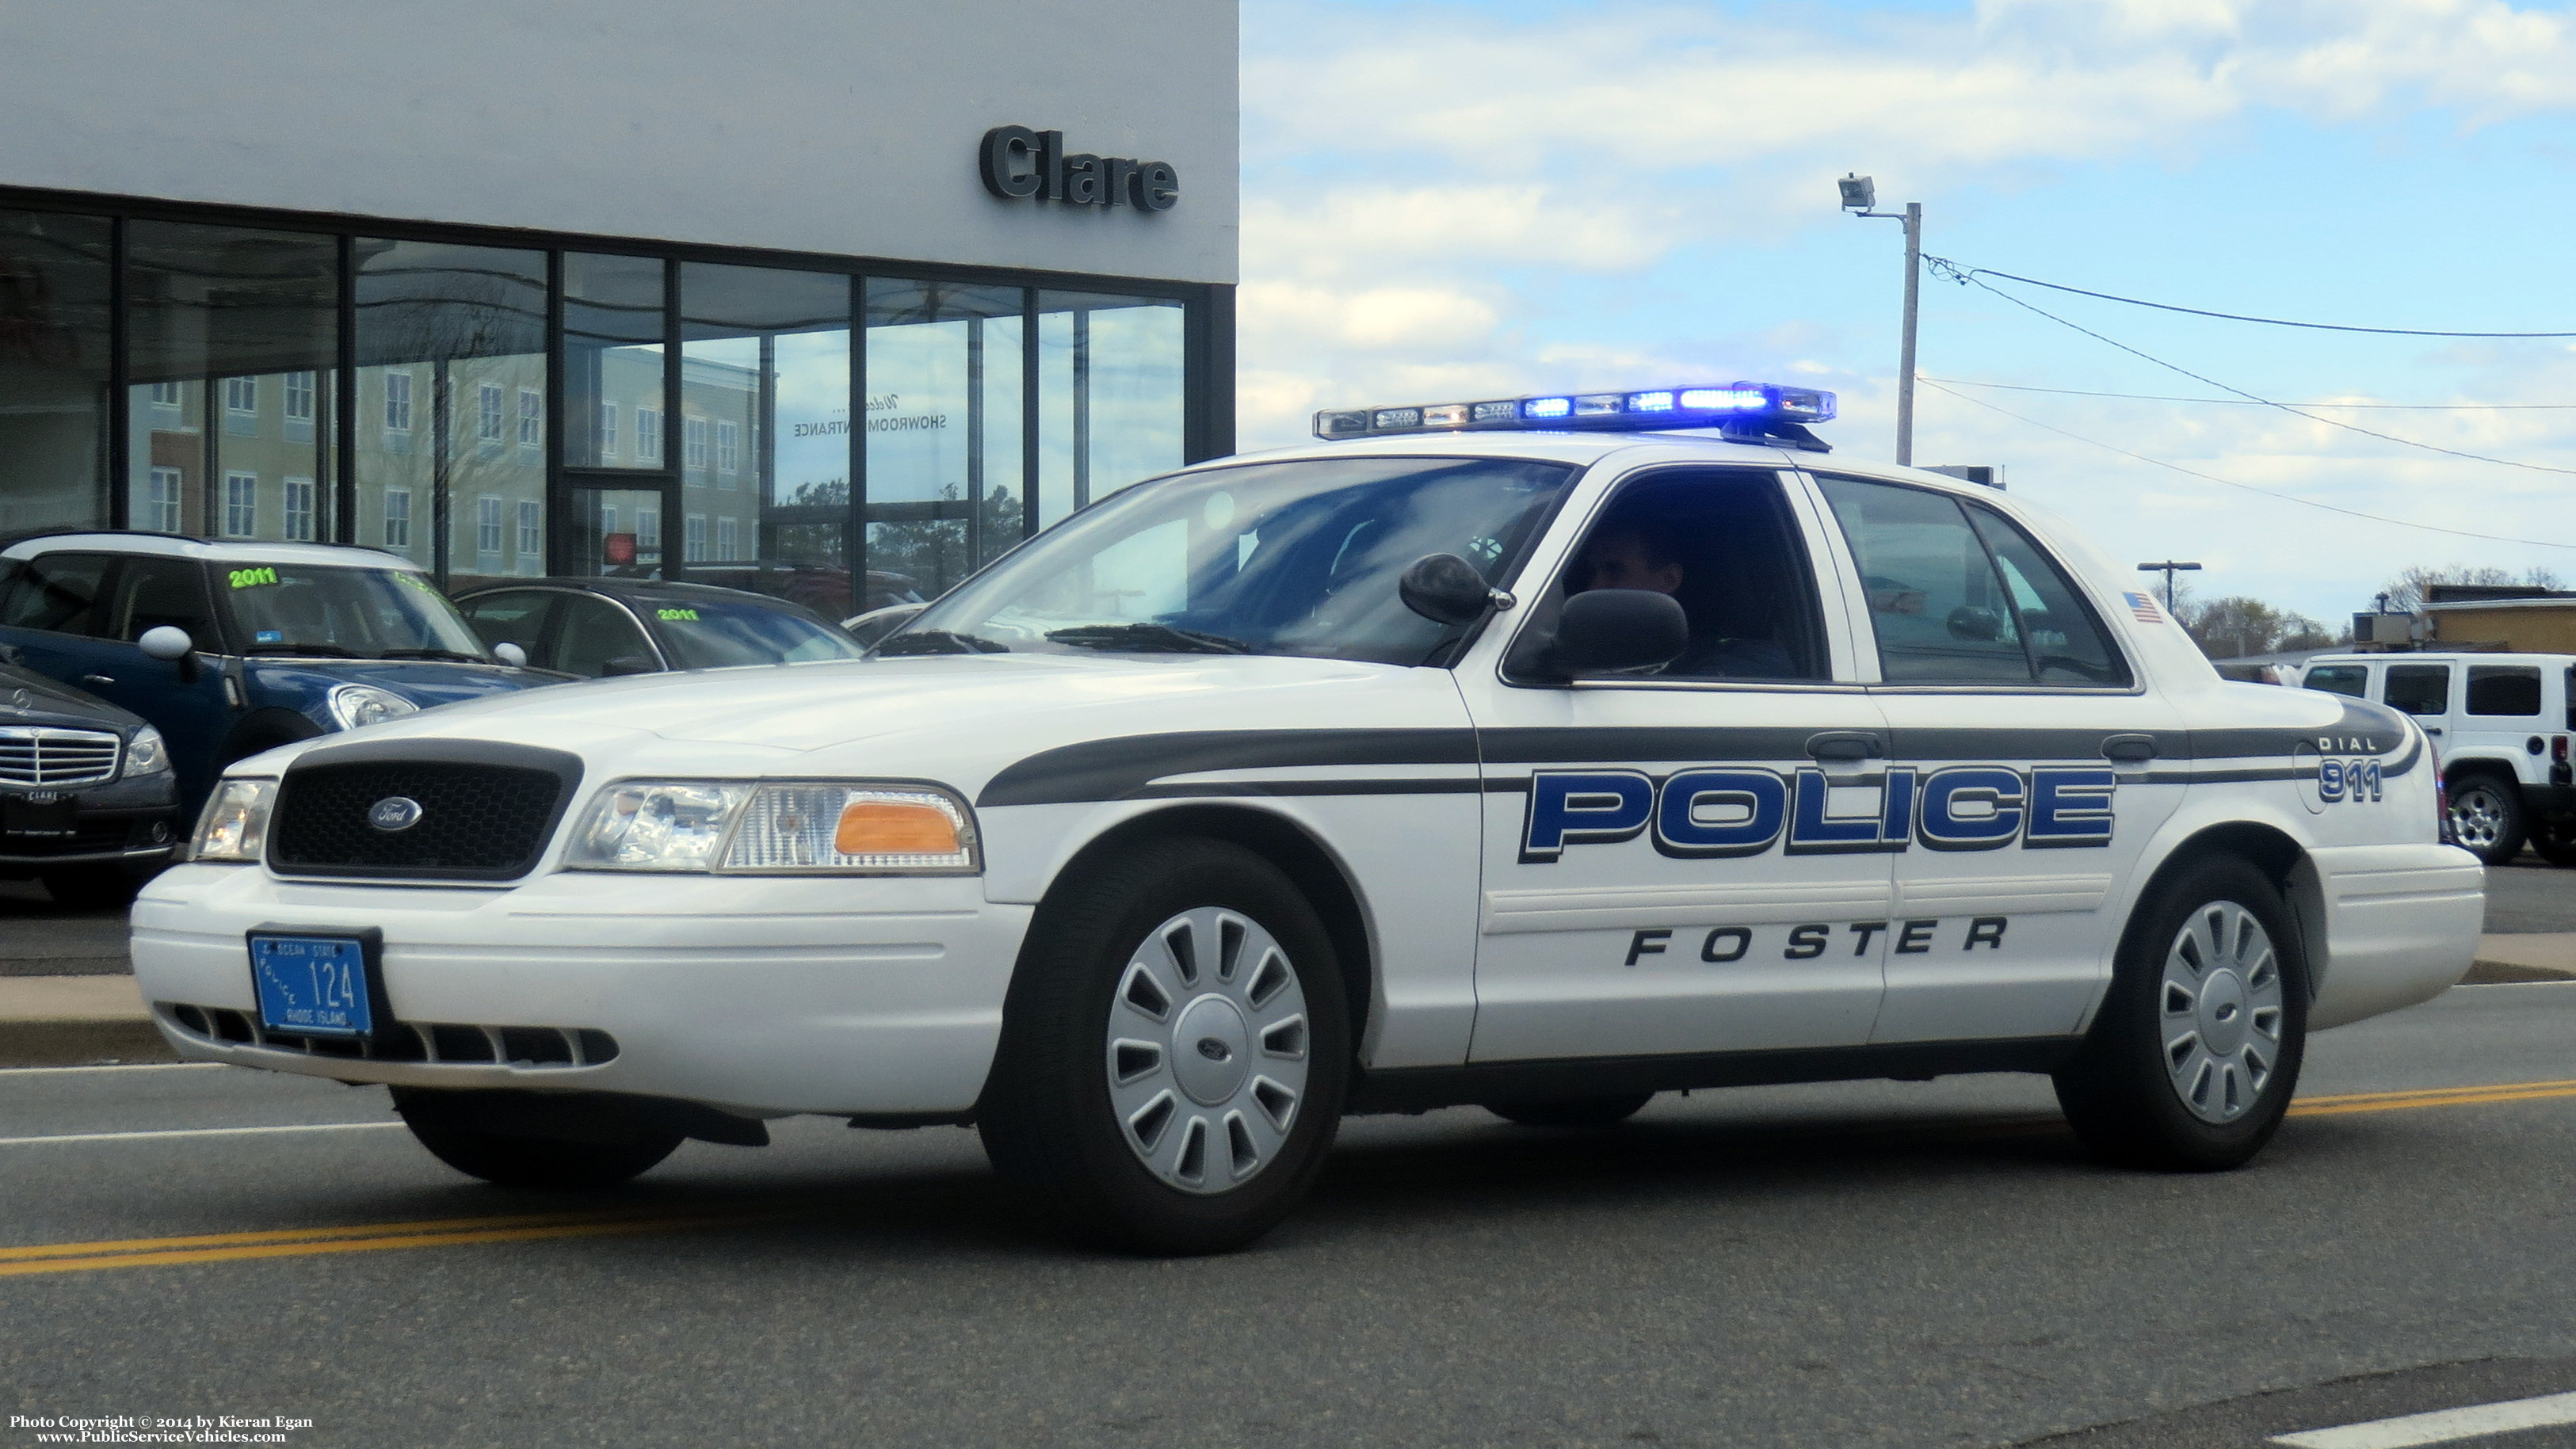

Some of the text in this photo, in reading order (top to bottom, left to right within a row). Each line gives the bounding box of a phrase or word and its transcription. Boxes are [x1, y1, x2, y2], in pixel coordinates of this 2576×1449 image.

[979, 125, 1179, 212] Clare
[229, 566, 277, 588] 2011
[657, 608, 700, 622] 2011
[2318, 737, 2376, 751] DIAL
[2318, 758, 2382, 803] 911
[378, 803, 408, 821] Ford
[1517, 765, 2116, 864] POLICE
[277, 943, 338, 959] OCEAN STATE
[1624, 917, 2008, 966] FOSTER
[259, 957, 296, 1005] POLICE
[309, 961, 355, 1008] 124
[286, 1008, 347, 1025] RHODE ISLAND
